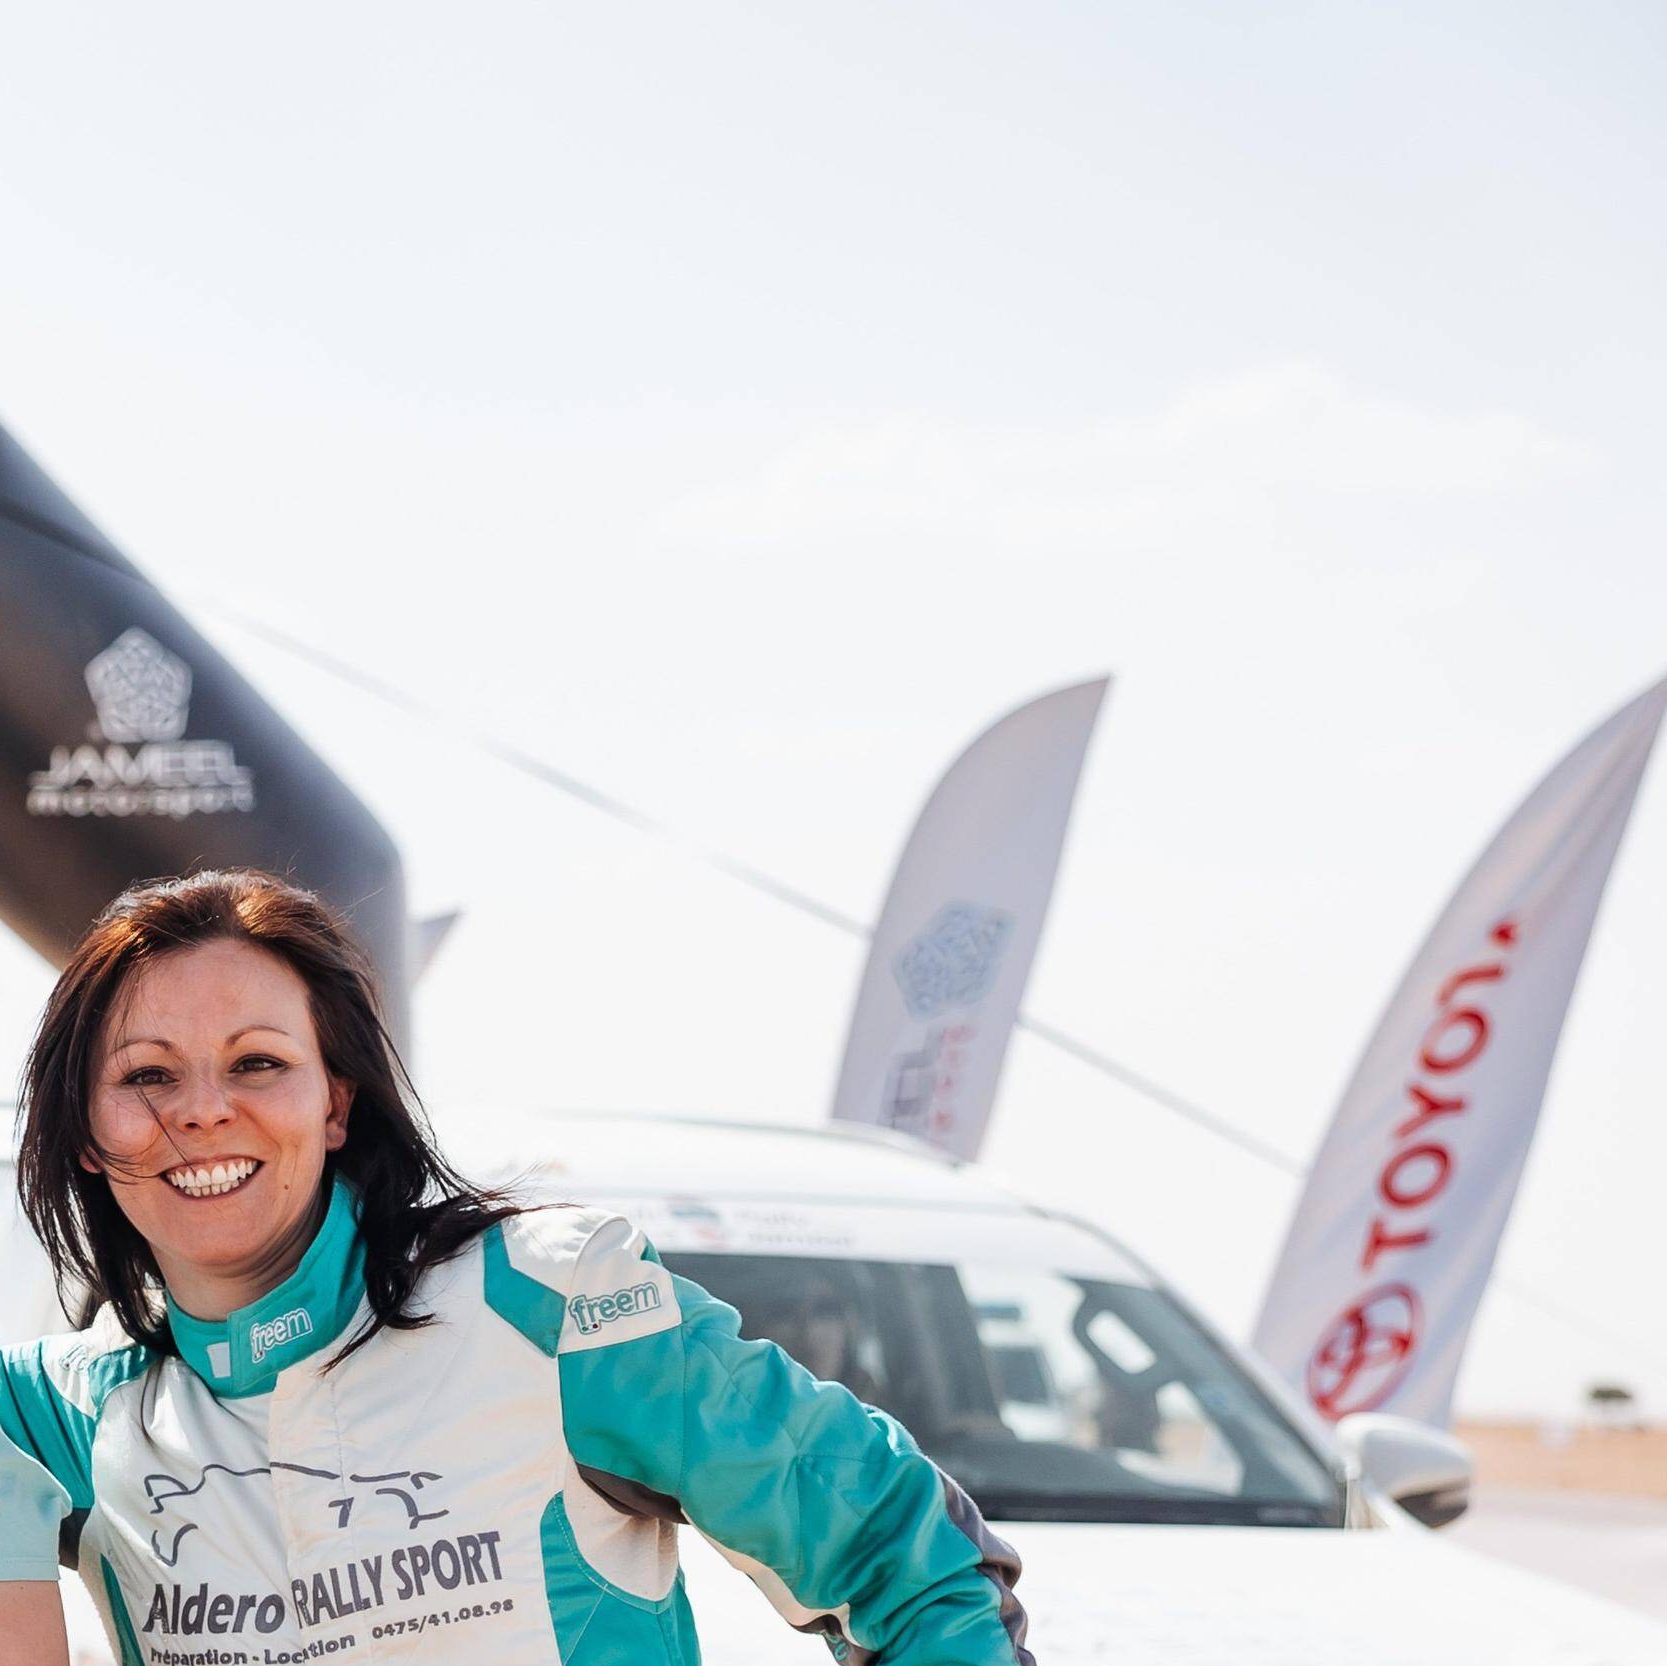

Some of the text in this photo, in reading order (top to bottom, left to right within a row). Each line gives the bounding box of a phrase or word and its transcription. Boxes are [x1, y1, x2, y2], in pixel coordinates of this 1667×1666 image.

[28, 739, 255, 788] JAMEEL
[1357, 915, 1520, 1273] TOYOT
[569, 1282, 661, 1333] freem
[251, 1308, 313, 1360] freem
[142, 1530, 504, 1637] Aldero RALLY SPORT
[371, 1598, 515, 1640] 0475/41.08.98
